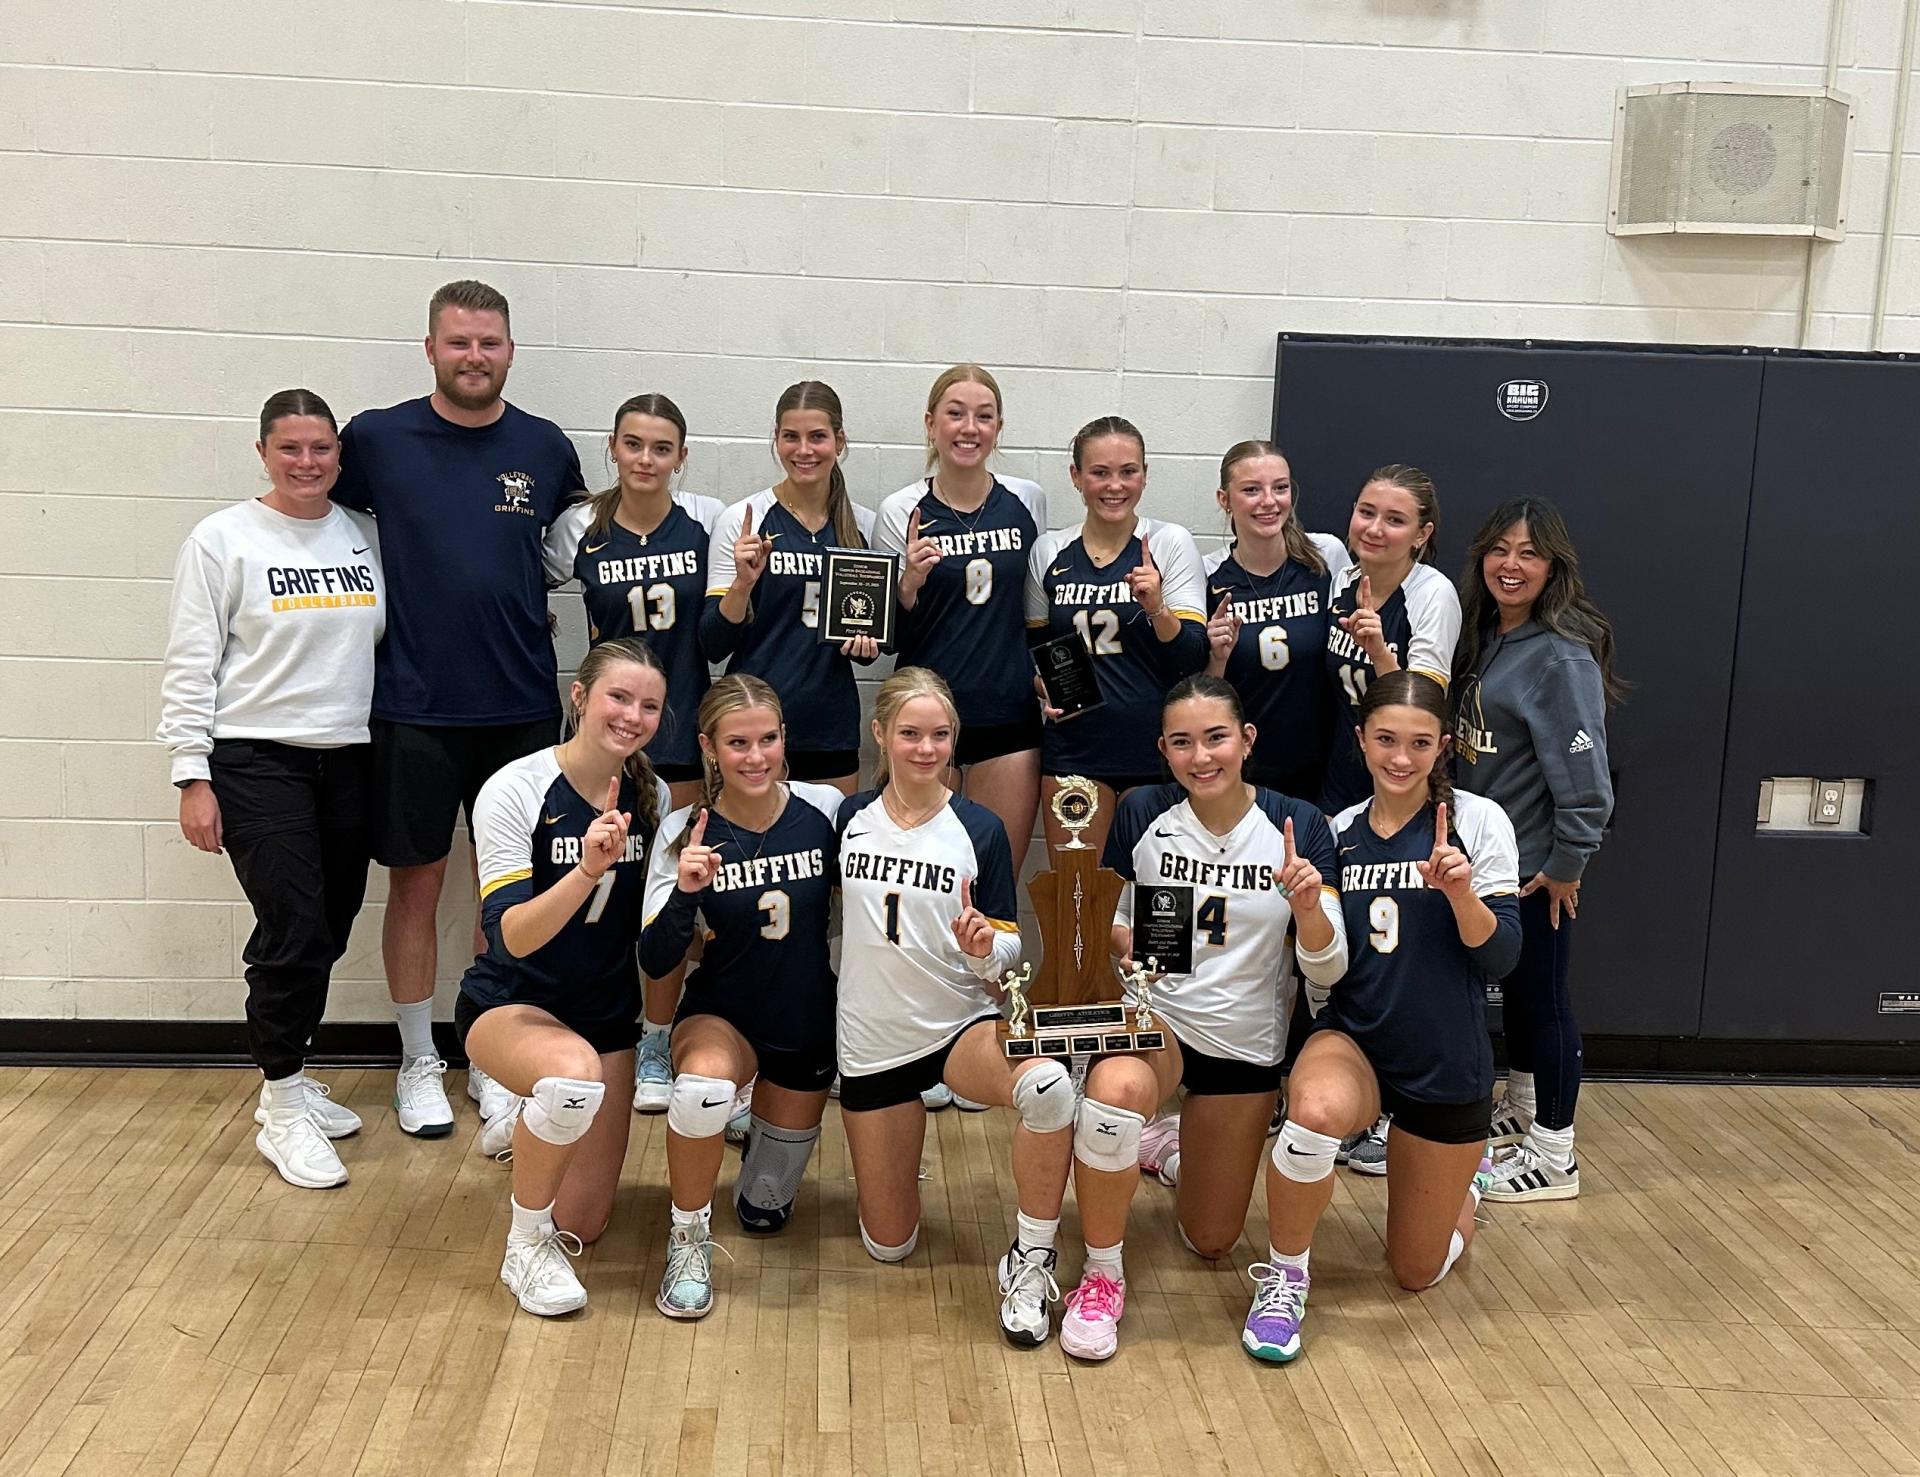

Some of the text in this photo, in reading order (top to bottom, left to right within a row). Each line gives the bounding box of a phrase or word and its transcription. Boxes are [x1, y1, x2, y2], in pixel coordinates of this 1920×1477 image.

[1507, 384, 1539, 396] BIG
[1507, 396, 1538, 404] KAHUNA
[496, 471, 536, 487] VOLLEYBALL
[495, 504, 535, 516] GRIFFINS
[267, 565, 375, 597] GRIFFINS
[598, 549, 698, 585] GRIFFINS
[769, 551, 823, 576] GRIF
[965, 558, 993, 605] 8
[276, 594, 375, 611] VOLLEYBALL
[627, 582, 676, 632] 13
[1054, 581, 1138, 605] GRIFFIN
[1072, 609, 1123, 655] 12
[1258, 625, 1290, 671] 6
[1339, 664, 1368, 706] 11
[1569, 741, 1594, 754] adida
[713, 848, 824, 893] GRIFFINS
[845, 852, 956, 894] GRIFFINS
[1160, 851, 1273, 891] GRIFFINS
[1342, 860, 1435, 893] GRIFFIN
[584, 869, 617, 924] 7
[757, 889, 791, 941] 3
[883, 889, 902, 946] 1
[1195, 894, 1229, 947] 4
[1369, 896, 1399, 954] 9
